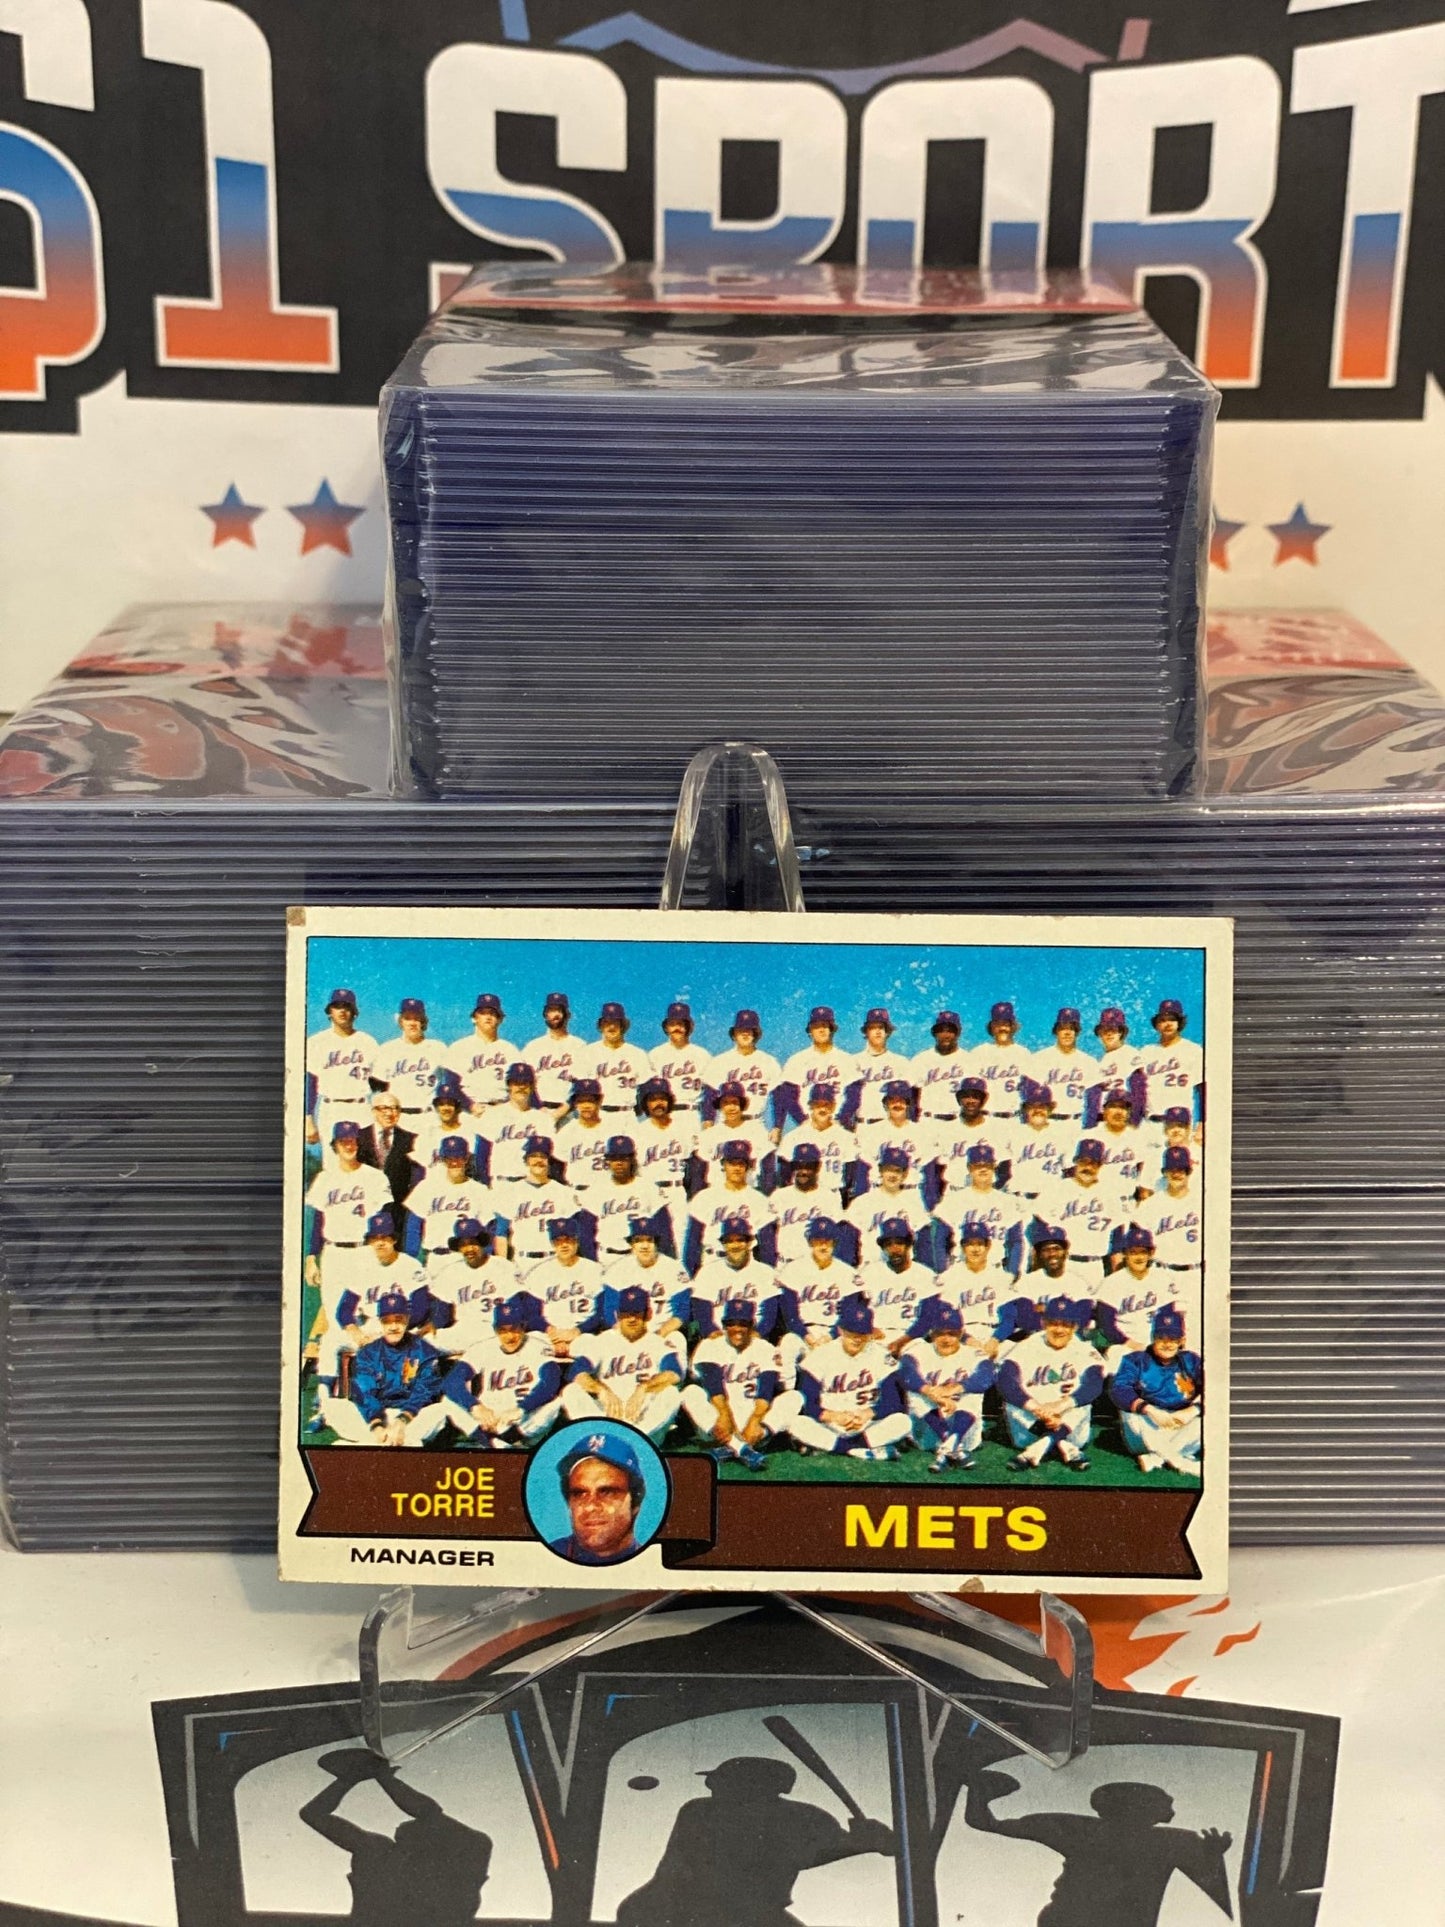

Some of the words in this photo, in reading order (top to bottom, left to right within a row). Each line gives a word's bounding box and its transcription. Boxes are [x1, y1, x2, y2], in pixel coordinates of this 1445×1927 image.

[323, 1049, 364, 1069] Mets
[392, 1057, 430, 1078] Mets
[468, 1052, 507, 1073] Mets
[536, 1053, 573, 1073] Mets
[596, 1059, 632, 1078] Mets
[1147, 1057, 1181, 1076] Mets
[661, 1060, 696, 1080] Mets
[727, 1065, 762, 1082] Mets
[802, 1064, 840, 1087] Mets
[923, 1064, 964, 1084] Mets
[984, 1065, 1019, 1079] Mets
[1045, 1069, 1083, 1085] Mets
[1165, 1074, 1188, 1087] 26
[747, 1083, 768, 1096] 45
[495, 1125, 537, 1143] Mets
[570, 1141, 605, 1162] Mets
[643, 1139, 682, 1166] Mets
[1017, 1143, 1056, 1163] Mets
[325, 1185, 365, 1207] Mets
[428, 1197, 471, 1215] Mets
[352, 1204, 365, 1217] 4
[515, 1200, 555, 1221] Mets
[601, 1196, 640, 1218] Mets
[712, 1204, 750, 1225] Mets
[782, 1206, 822, 1226] Mets
[962, 1208, 1002, 1224] Mets
[1060, 1199, 1104, 1220] Mets
[1088, 1216, 1111, 1231] 27
[1155, 1212, 1199, 1235] Mets
[1186, 1230, 1198, 1242] 6
[457, 1280, 496, 1304] Mets
[545, 1281, 584, 1304] Mets
[714, 1283, 758, 1306] Mets
[799, 1284, 840, 1302] Mets
[873, 1287, 917, 1306] Mets
[958, 1285, 996, 1308] Mets
[1118, 1291, 1157, 1314] Mets
[570, 1300, 589, 1312] 12
[603, 1352, 652, 1380] Mets
[722, 1362, 759, 1383] Mets
[1027, 1363, 1076, 1387] Mts
[489, 1365, 533, 1391] Mets
[827, 1369, 873, 1393] Mets
[436, 1467, 494, 1491] JOE
[391, 1493, 494, 1518] TORRE
[845, 1504, 1048, 1551] METS
[350, 1547, 495, 1566] MANAGER
